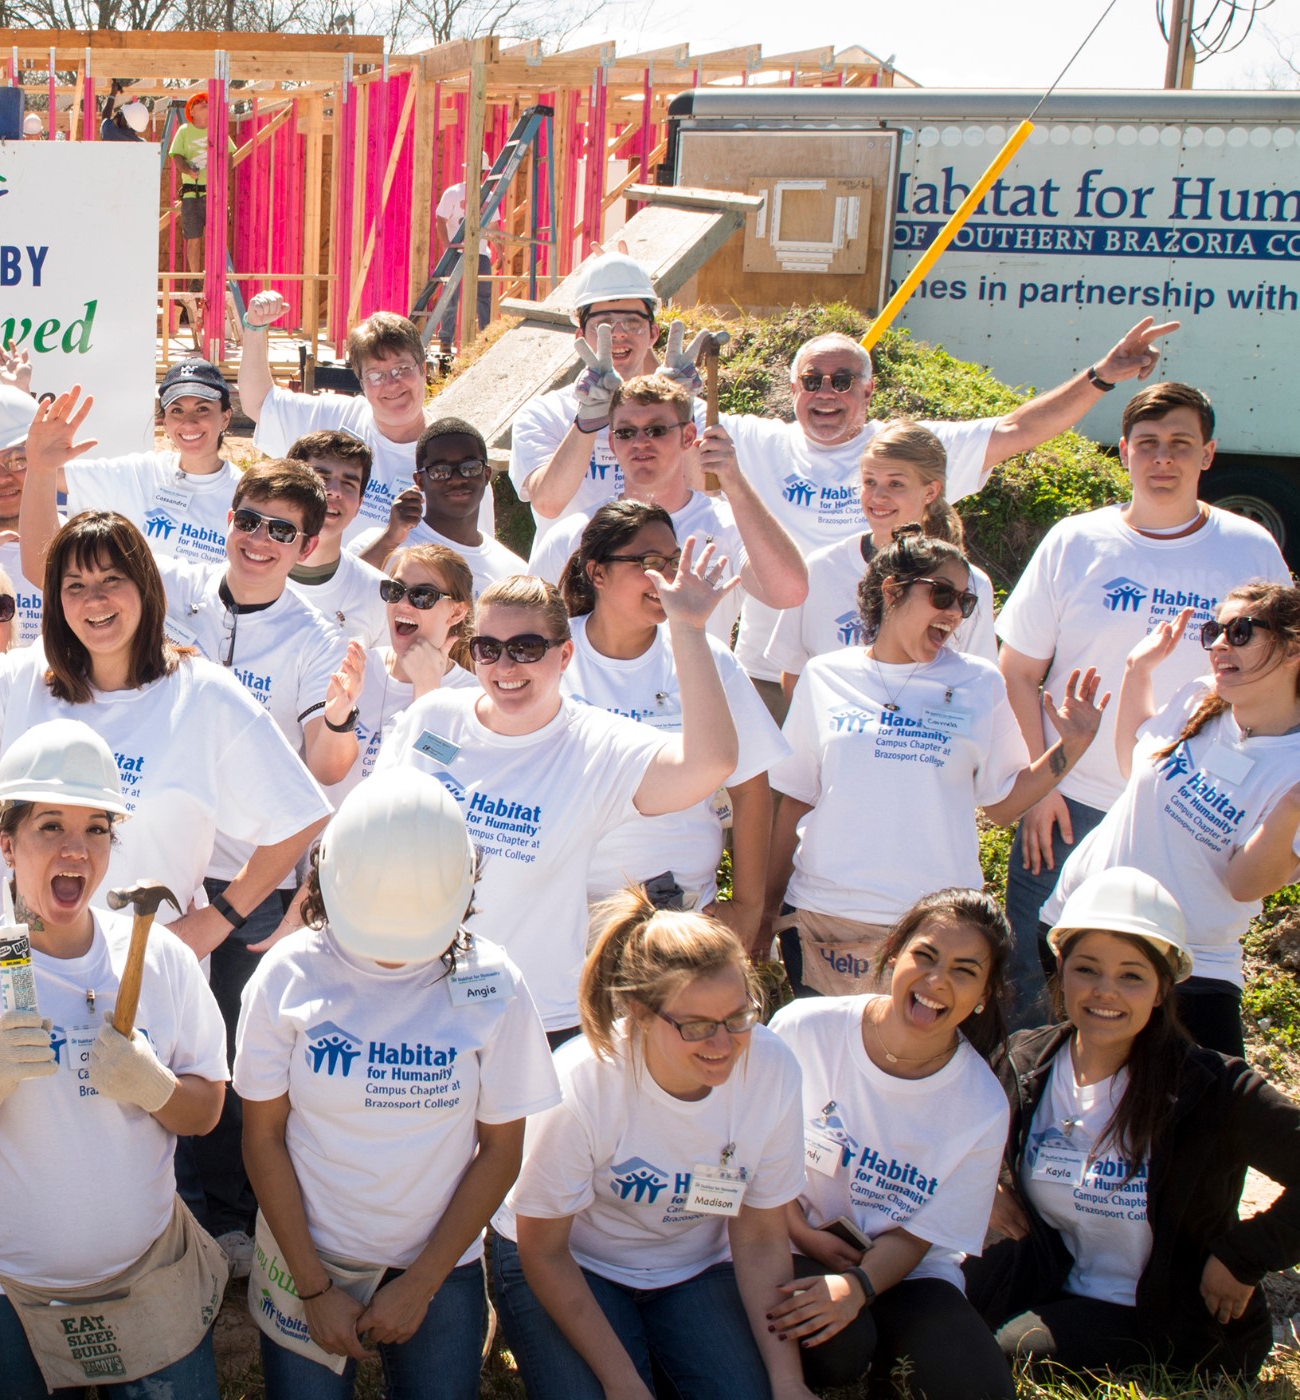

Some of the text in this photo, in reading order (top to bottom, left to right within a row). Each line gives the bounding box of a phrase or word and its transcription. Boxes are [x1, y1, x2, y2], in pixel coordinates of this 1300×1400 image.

[1074, 169, 1154, 219] for
[895, 225, 927, 245] OF
[938, 226, 1095, 250] OUTHERN
[1105, 230, 1256, 255] BRAZORIA
[0, 245, 49, 287] BY
[979, 275, 1007, 301] in
[1019, 279, 1215, 314] partnership
[1227, 283, 1298, 310] with
[820, 501, 832, 509] for
[818, 516, 852, 525] Brazosport
[178, 536, 190, 545] for
[180, 522, 226, 546] Habita
[175, 546, 199, 557] Campus
[1152, 588, 1218, 611] Habitat
[1150, 605, 1165, 614] for
[878, 728, 950, 744] for Humanity
[875, 737, 951, 756] Campus Chapter at
[874, 750, 945, 768] Brazosport College
[131, 788, 140, 797] at
[1186, 772, 1246, 825] Habitat
[470, 792, 541, 823] Habitat
[1177, 785, 1234, 835] for Humanity
[465, 811, 538, 837] for Humanity
[1164, 804, 1222, 853] Brazosport College
[1170, 795, 1231, 846] Campus Chapter at
[496, 832, 540, 849] Chapter at
[504, 848, 536, 864] College
[820, 948, 869, 978] Help
[467, 985, 497, 998] Angie
[368, 1041, 457, 1066] Habitat
[367, 1065, 453, 1082] for Humanity
[365, 1079, 461, 1097] Campus Chapter at
[364, 1096, 460, 1110] Brazosport College
[855, 1168, 873, 1183] for
[859, 1146, 938, 1195] Habitat
[1045, 1166, 1072, 1178] Kayla
[850, 1181, 885, 1200] Campus
[1073, 1188, 1147, 1207] Campus Chapte
[695, 1195, 733, 1208] Madison
[1074, 1202, 1124, 1219] Brazosport
[60, 1315, 111, 1335] EAT.
[67, 1330, 116, 1347] SLEEP.
[71, 1343, 121, 1360] BUILD.
